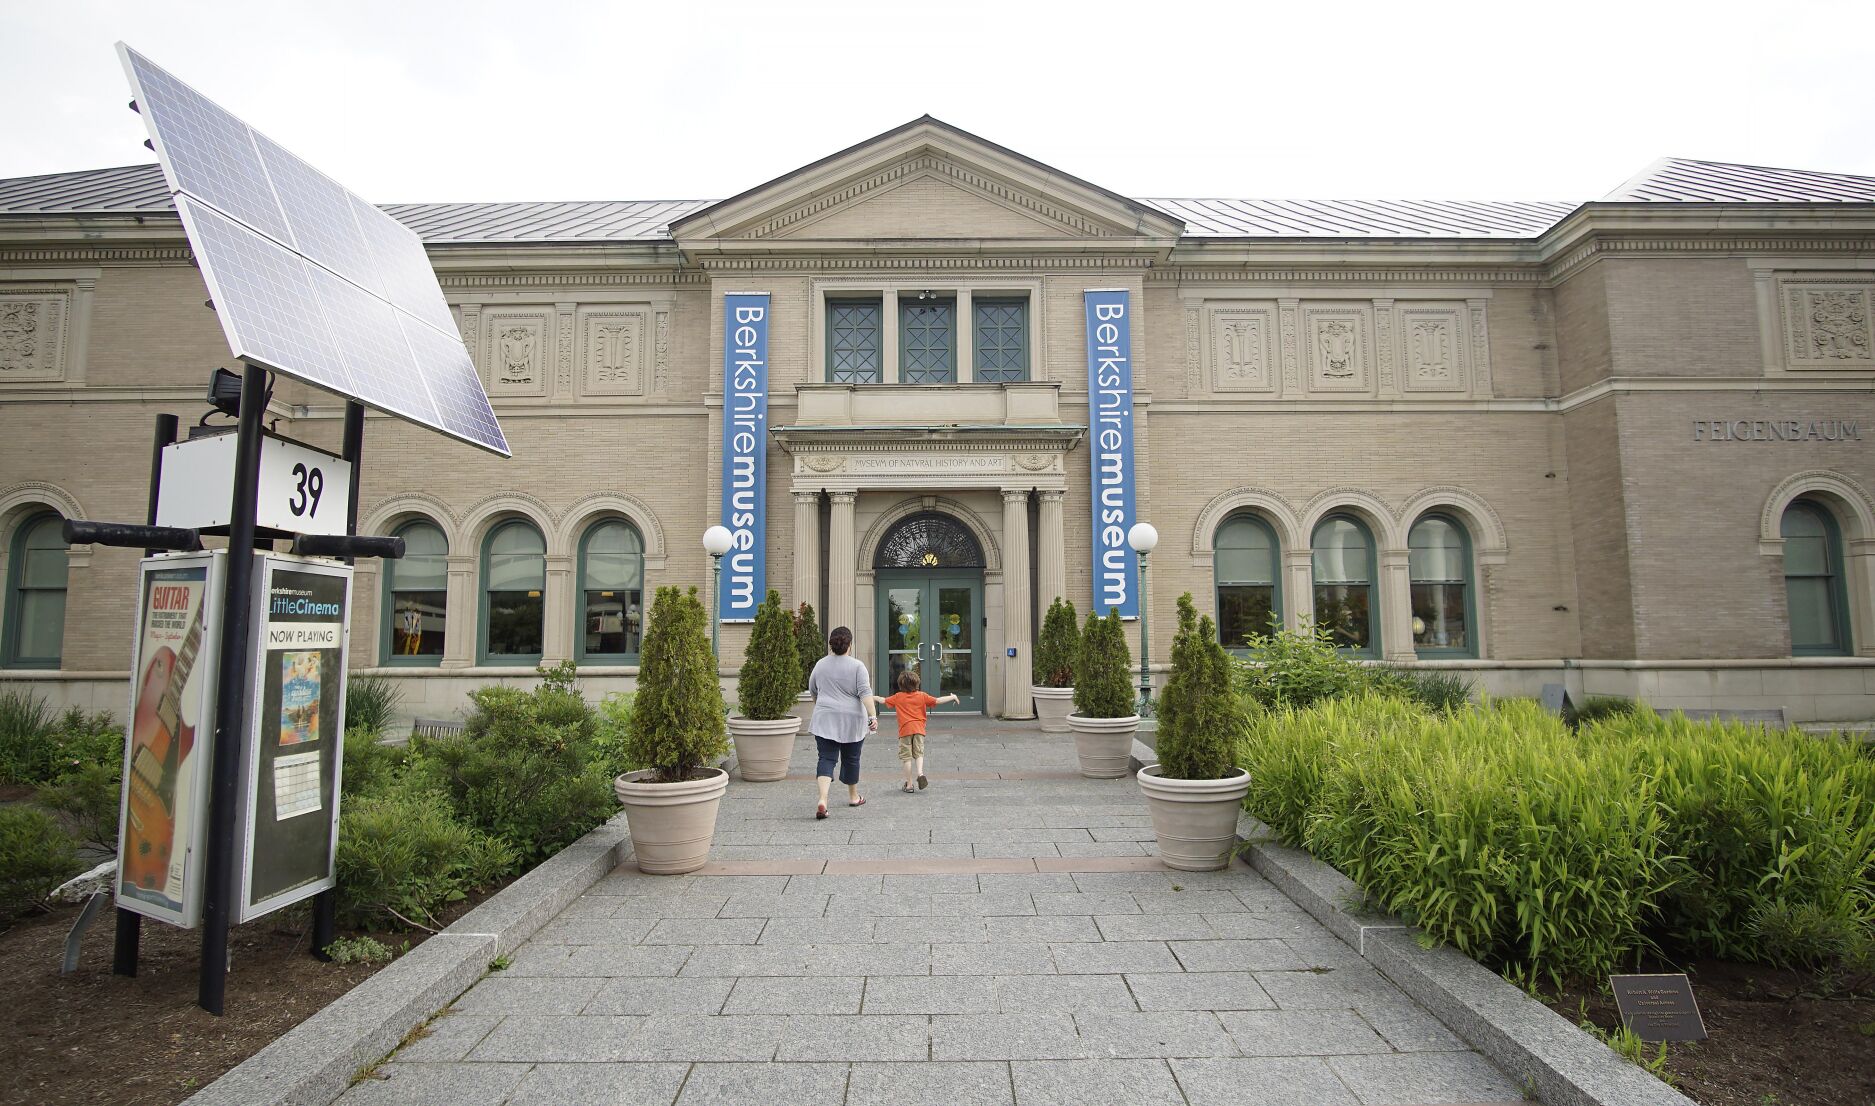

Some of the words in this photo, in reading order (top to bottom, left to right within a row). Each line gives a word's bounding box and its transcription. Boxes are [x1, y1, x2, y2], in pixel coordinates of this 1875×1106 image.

[1693, 420, 1863, 442] FEIGENBAUM
[731, 306, 764, 609] Berkshiremuseum
[889, 459, 898, 468] OF
[936, 458, 968, 467] HISTORY
[969, 458, 986, 467] AND
[988, 458, 1002, 467] ART
[1096, 304, 1128, 605] Berkshiremuseum
[289, 462, 324, 519] 39
[153, 586, 190, 610] GUITAR
[271, 587, 313, 597] erkshiremuseum
[270, 630, 295, 643] NOW
[297, 630, 334, 643] PLAYING
